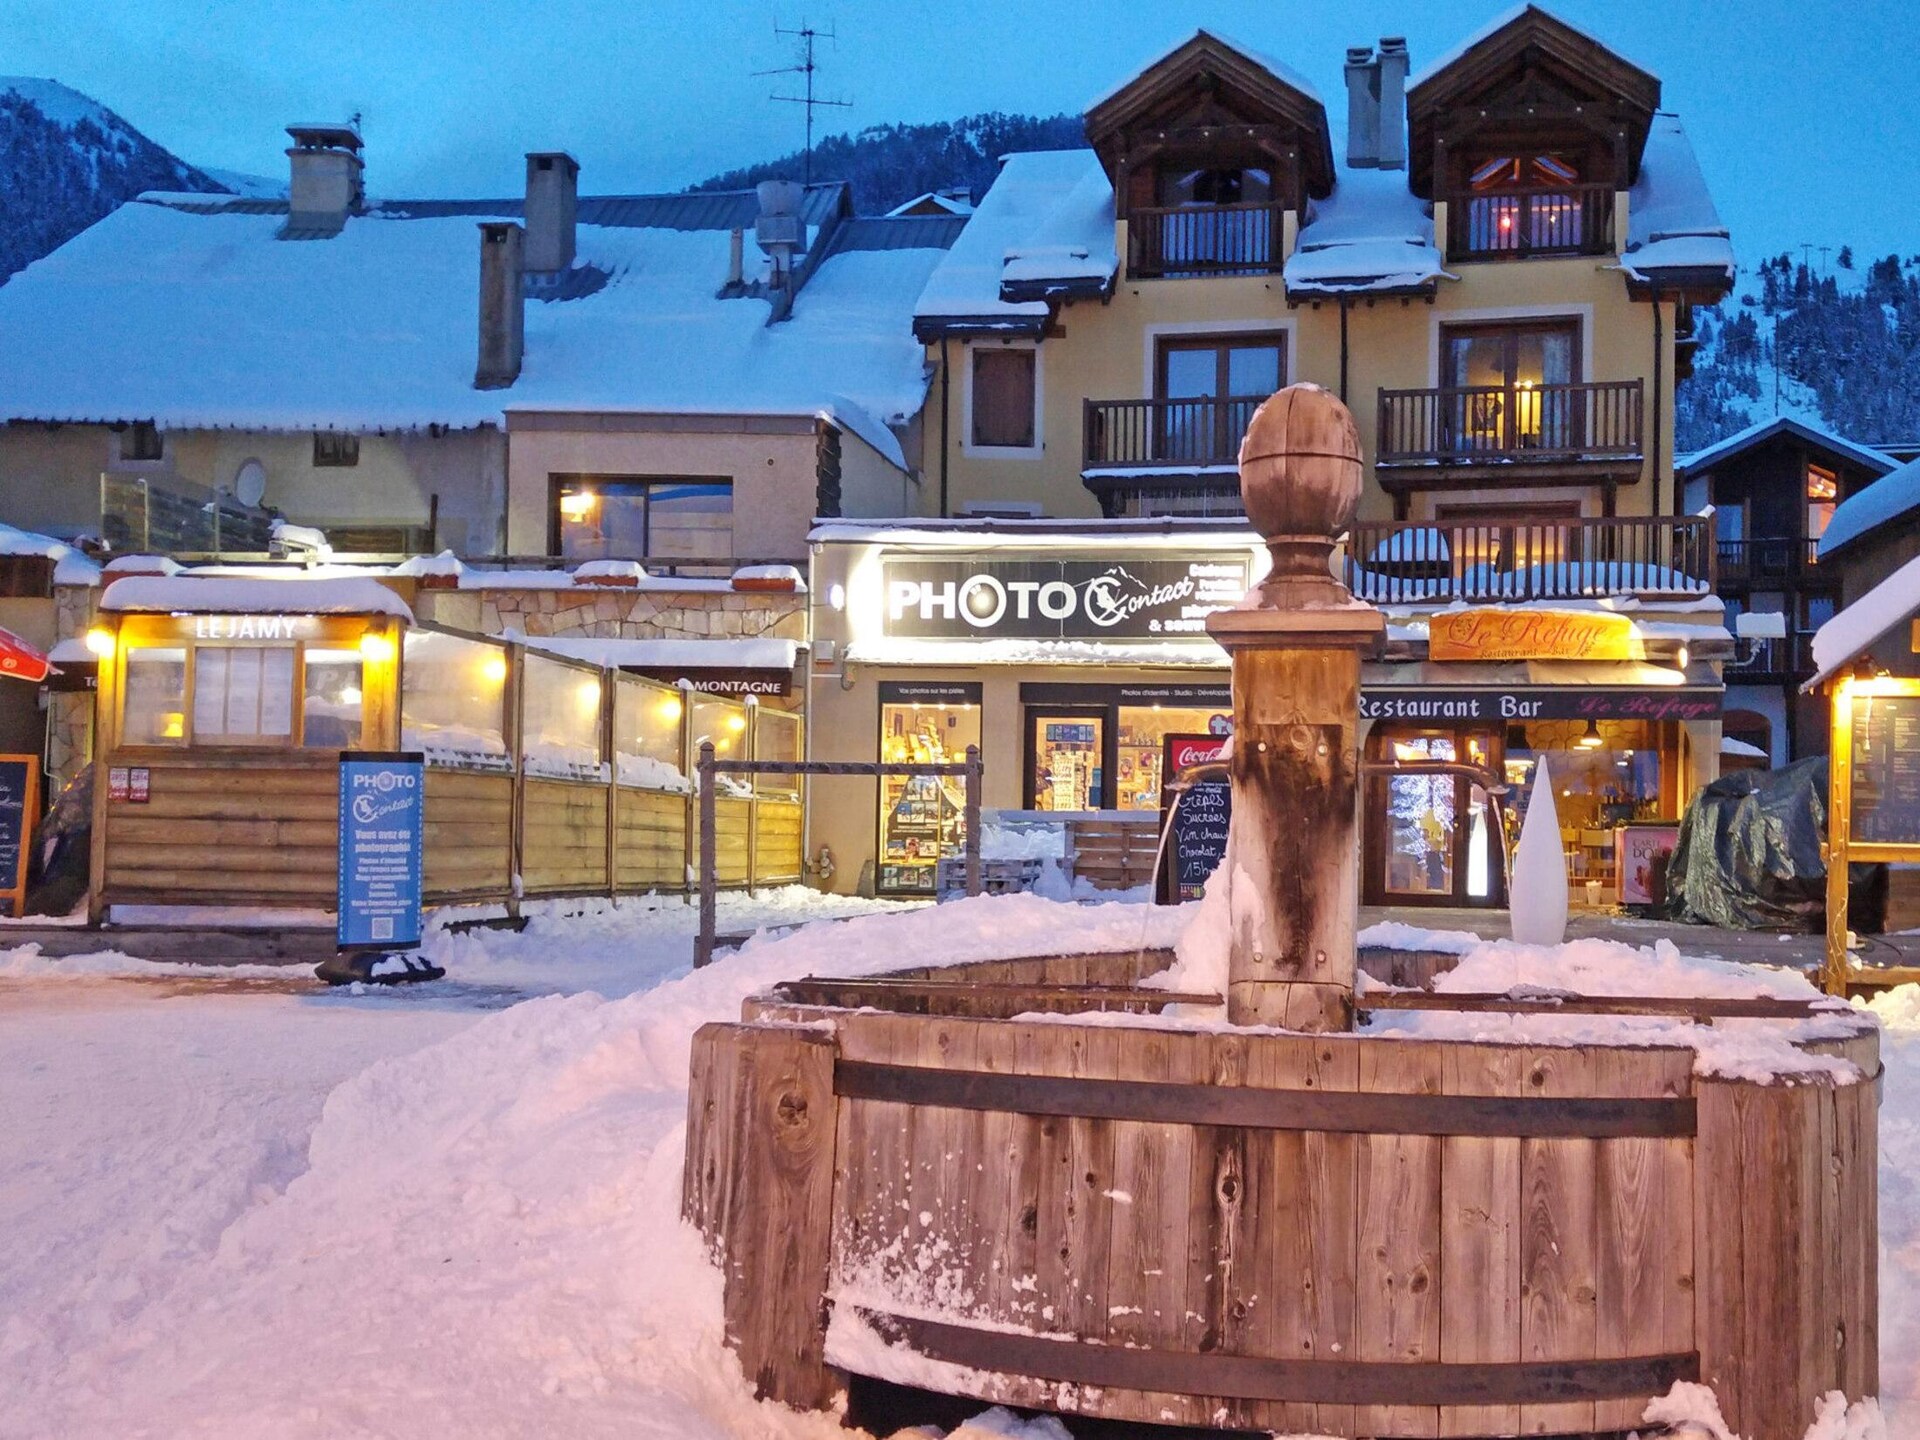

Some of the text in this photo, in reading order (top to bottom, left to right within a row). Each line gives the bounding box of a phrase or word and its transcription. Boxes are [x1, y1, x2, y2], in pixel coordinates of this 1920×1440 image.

[889, 574, 1077, 628] PHOTO
[196, 616, 297, 639] LE JAMY
[1149, 619, 1161, 632] &
[1449, 611, 1608, 657] Le Refuge
[694, 681, 782, 693] MONTAGNE
[1198, 689, 1232, 697] Développe
[1357, 695, 1717, 720] Restaurant Bar Le Refuge
[353, 771, 416, 791] PHOTO
[1175, 827, 1199, 843] Vin
